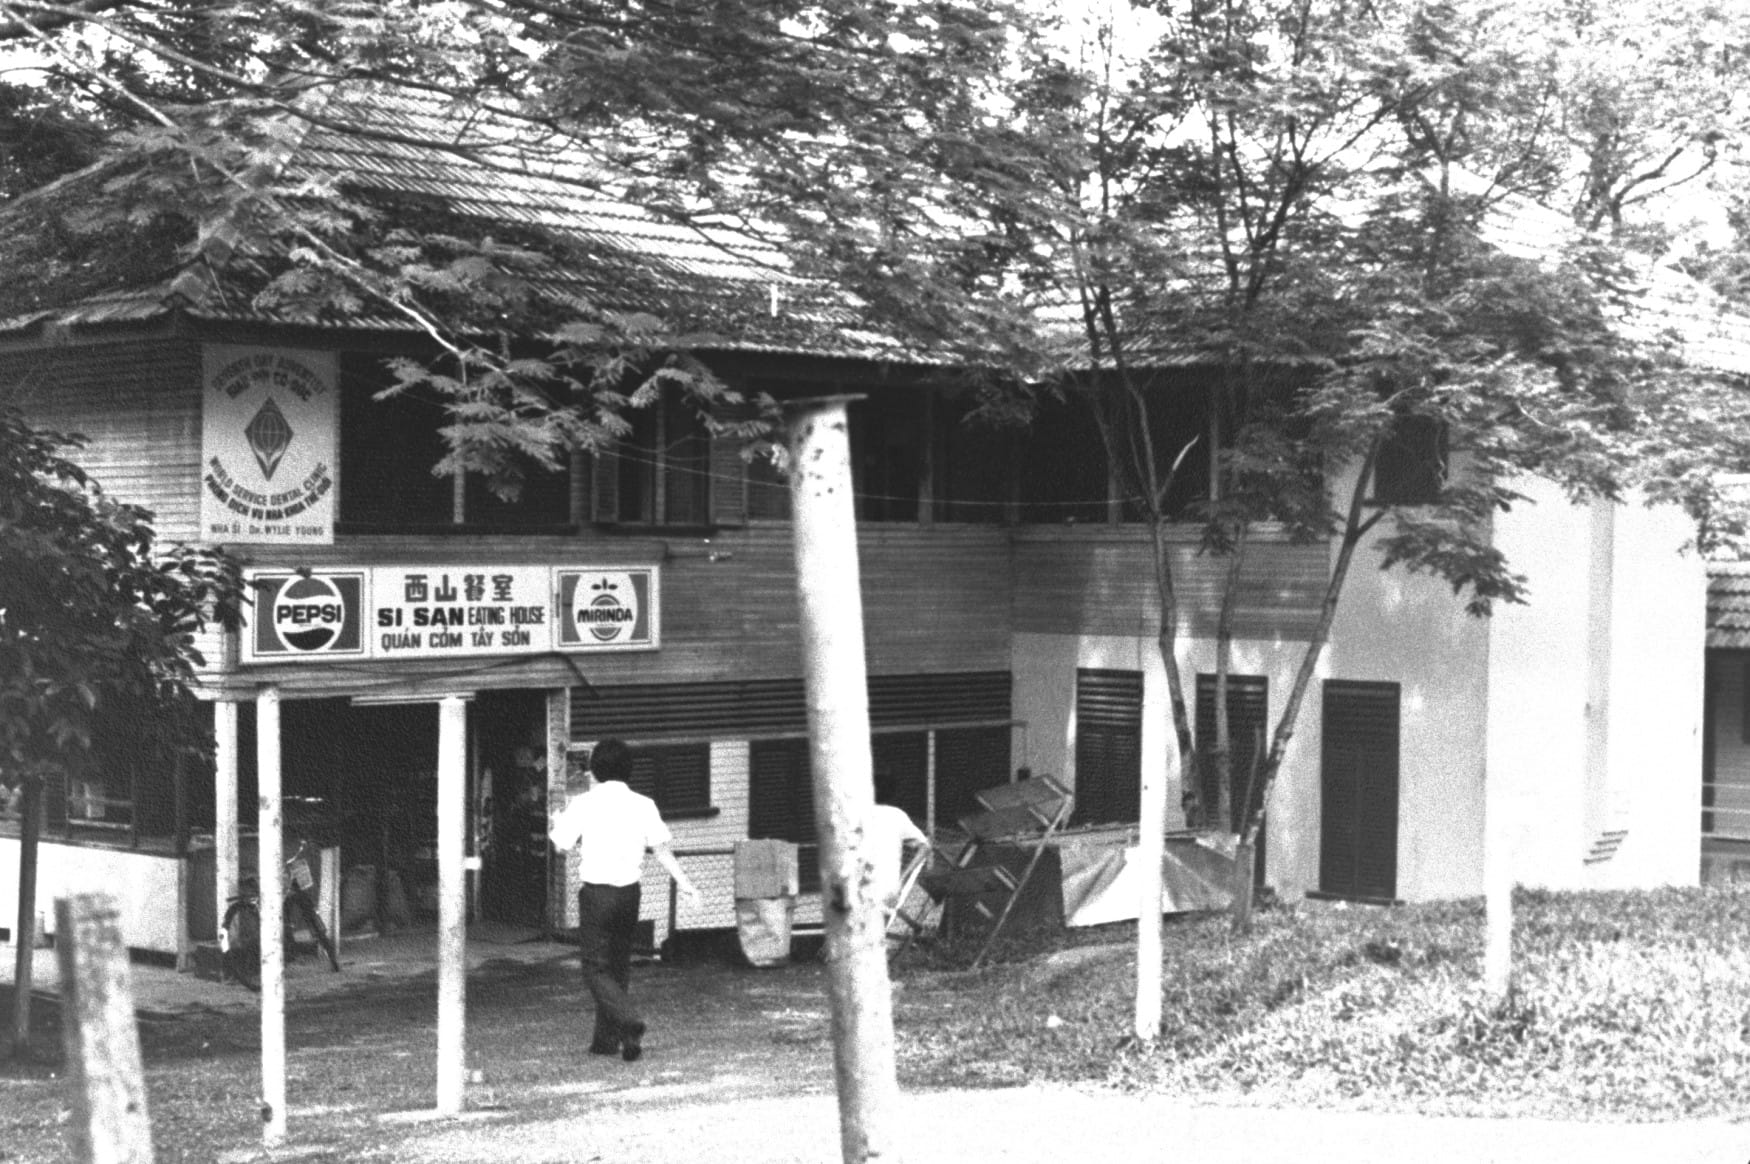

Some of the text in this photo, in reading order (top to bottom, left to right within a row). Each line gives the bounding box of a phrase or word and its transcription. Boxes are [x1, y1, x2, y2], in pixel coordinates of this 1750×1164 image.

[232, 484, 267, 506] SERVICE
[270, 487, 305, 506] DENTAL
[303, 462, 327, 490] CLINIC
[296, 526, 324, 537] YOUNG
[276, 604, 342, 624] PEPSI
[378, 606, 545, 627] SI SAN EATING HOUSE
[577, 608, 633, 623] MIRINDA
